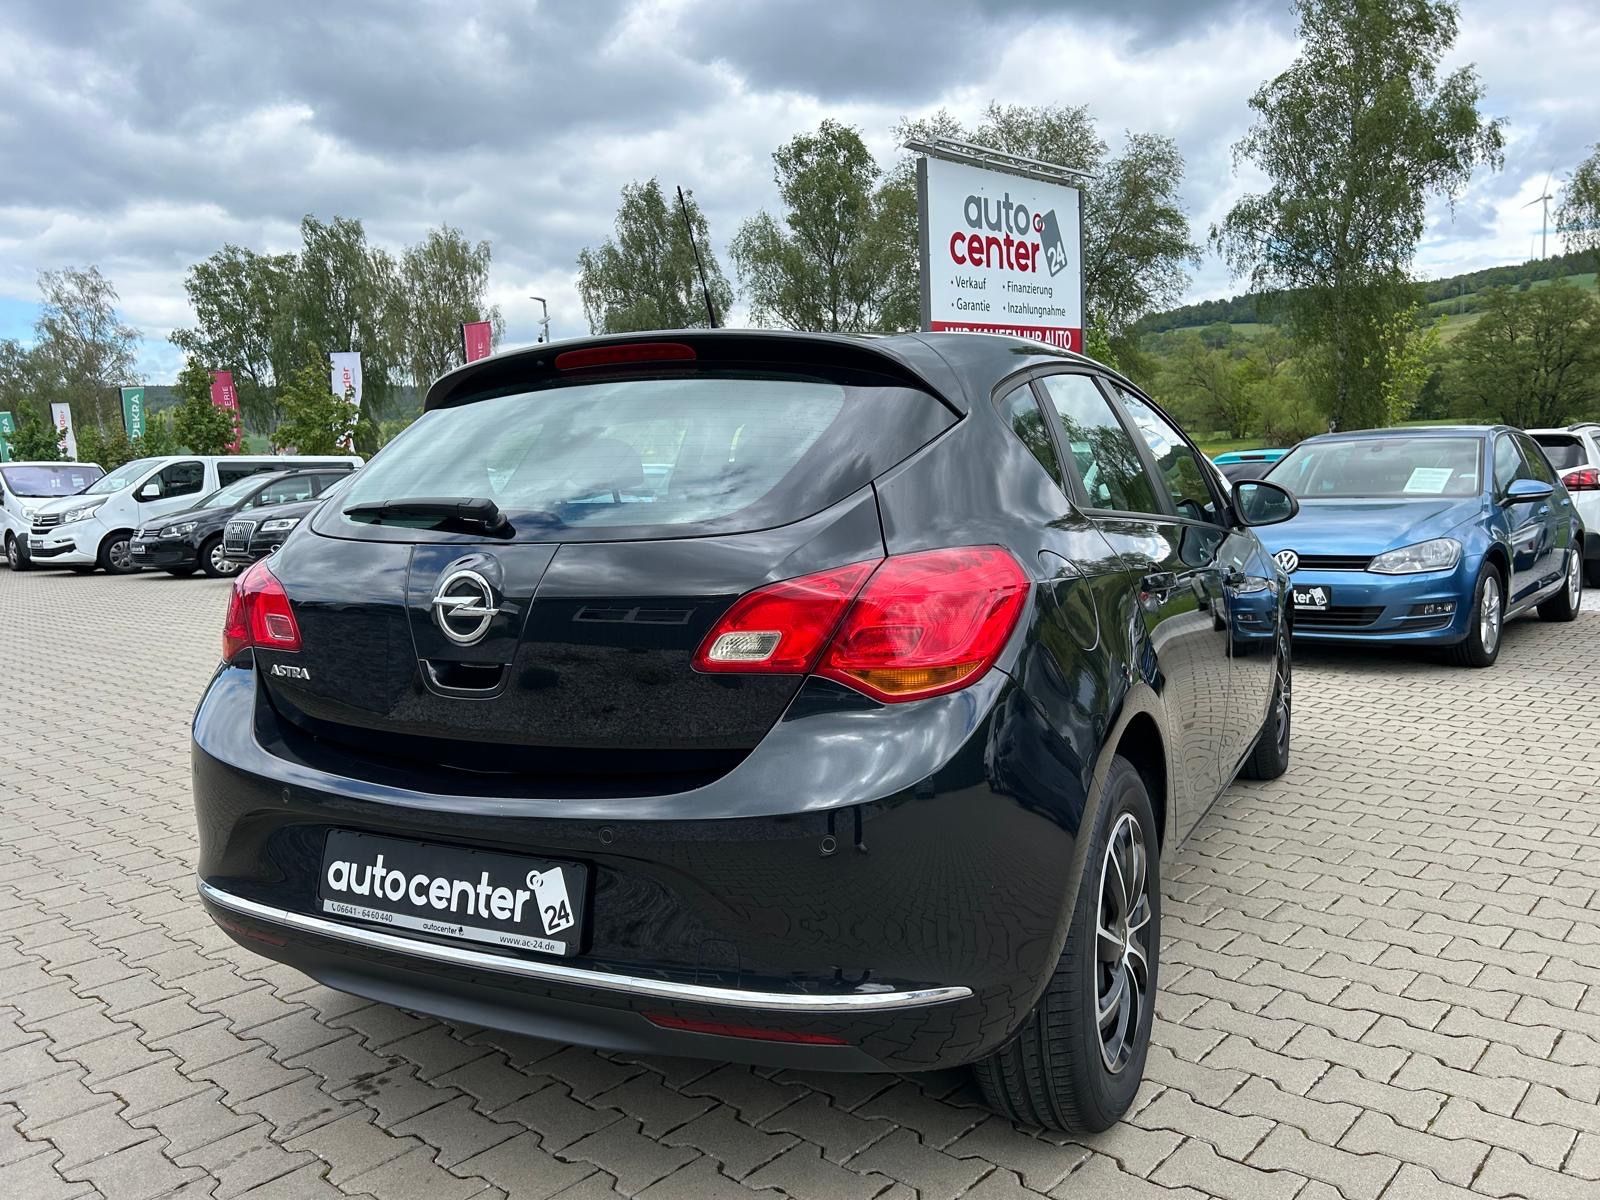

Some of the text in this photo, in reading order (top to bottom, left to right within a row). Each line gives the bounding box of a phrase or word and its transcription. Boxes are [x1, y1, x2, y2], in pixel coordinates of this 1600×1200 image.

[964, 192, 1030, 235] auto
[950, 231, 1040, 273] center
[1047, 241, 1066, 273] 24
[955, 275, 987, 290] Verkauf
[1007, 281, 1053, 298] Finanzierung
[956, 297, 991, 312] Garantie
[1007, 301, 1066, 318] Inzahlungnahme
[1044, 330, 1072, 349] AUTO
[131, 393, 141, 438] DEKRA
[270, 664, 310, 680] ASTRA
[327, 854, 570, 930] autocenter 24
[422, 922, 457, 935] autocenter
[499, 936, 555, 952] www.ac-24.de
